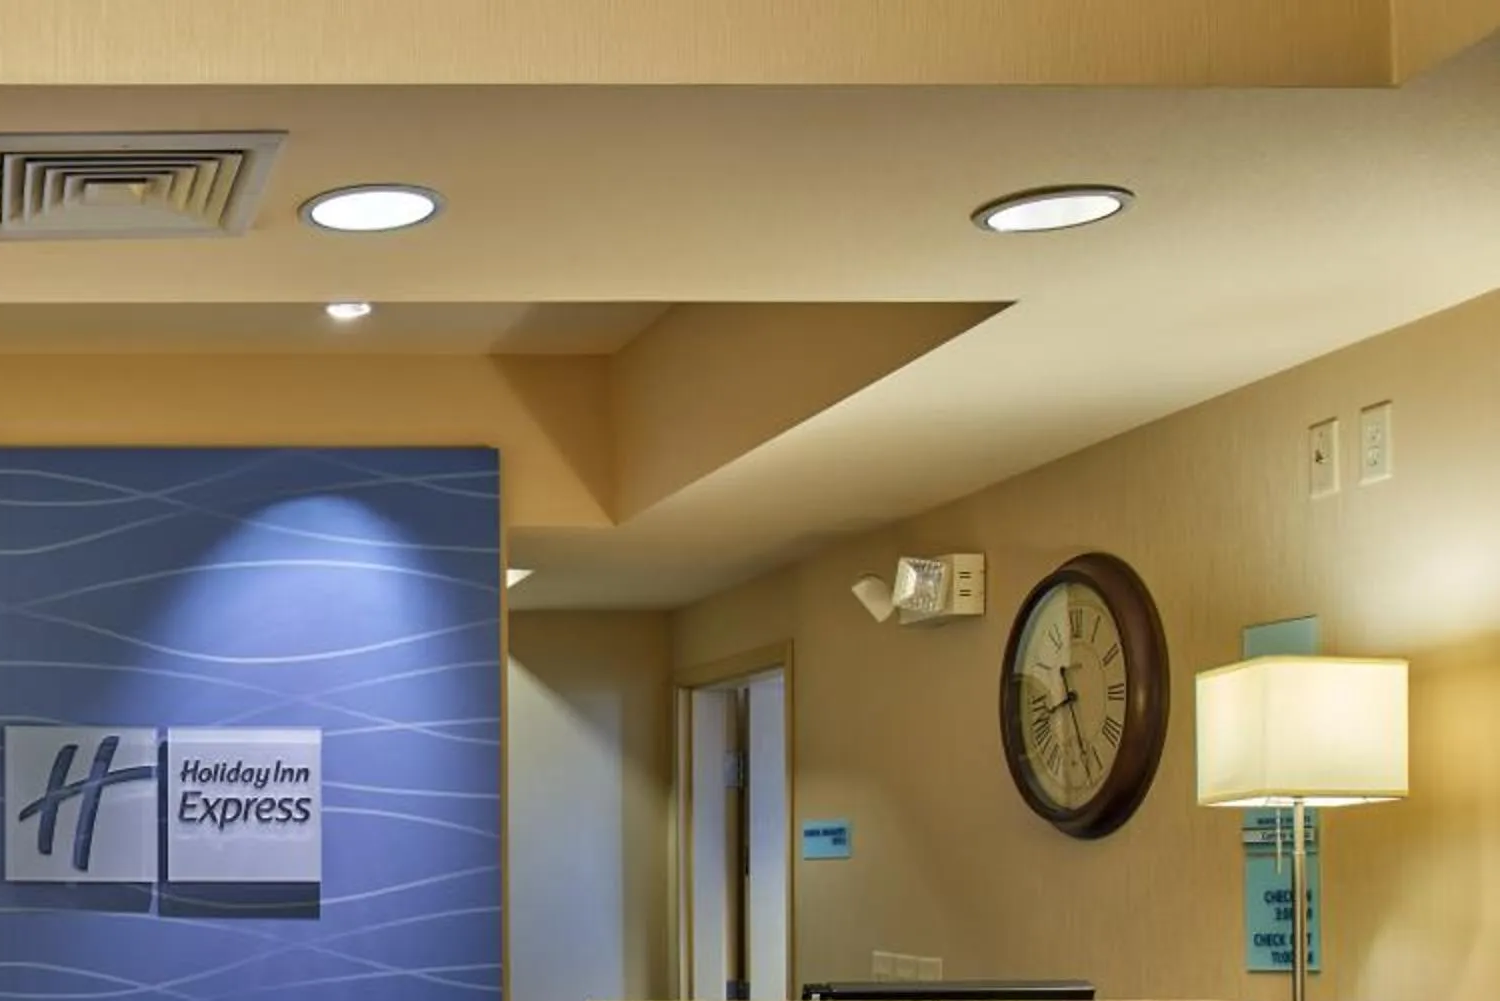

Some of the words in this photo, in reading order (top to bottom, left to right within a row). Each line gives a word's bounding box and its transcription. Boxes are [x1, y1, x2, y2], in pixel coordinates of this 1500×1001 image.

[181, 759, 270, 789] Holiday
[273, 760, 311, 784] Inn
[178, 791, 312, 830] Express
[1253, 933, 1286, 946] CHECK
